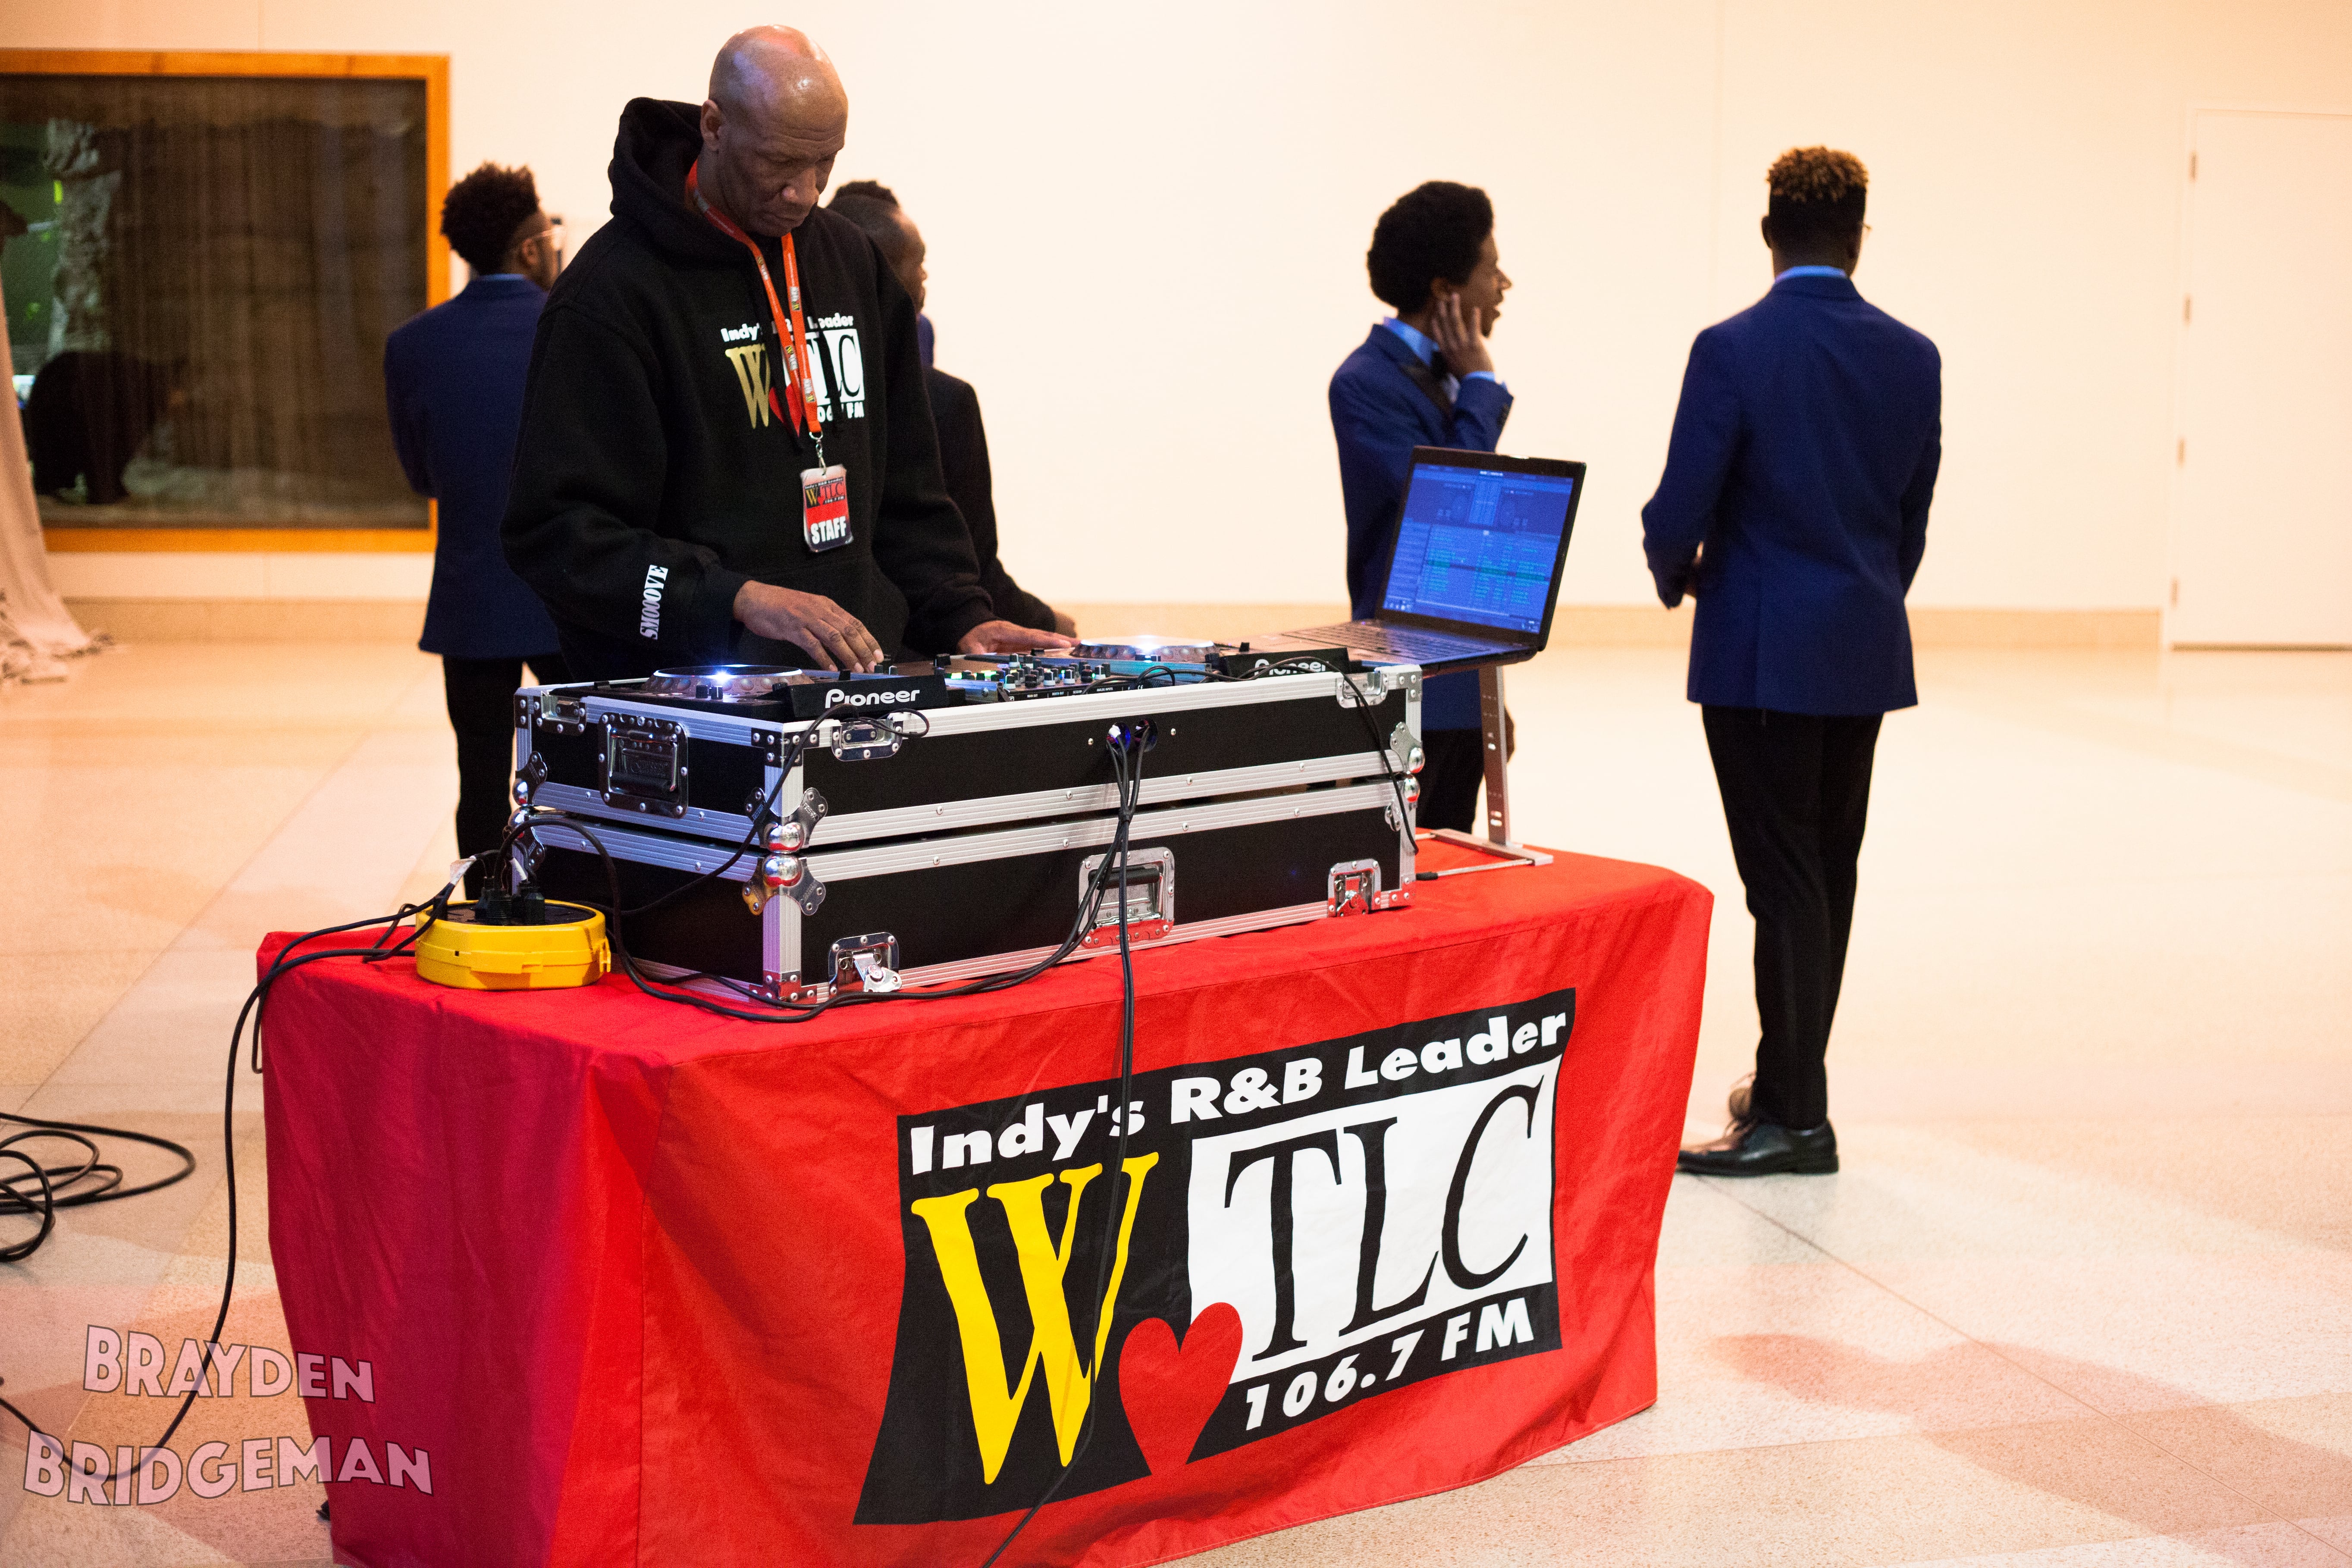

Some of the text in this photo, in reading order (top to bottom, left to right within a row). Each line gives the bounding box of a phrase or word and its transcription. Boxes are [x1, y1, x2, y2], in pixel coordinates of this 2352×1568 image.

[810, 516, 847, 544] STAFF
[640, 564, 668, 640] SMOOOVE
[825, 689, 920, 709] Pioneer
[911, 1012, 1567, 1175] Indy's R&B Leader
[1246, 1297, 1534, 1431] 106.7 FM
